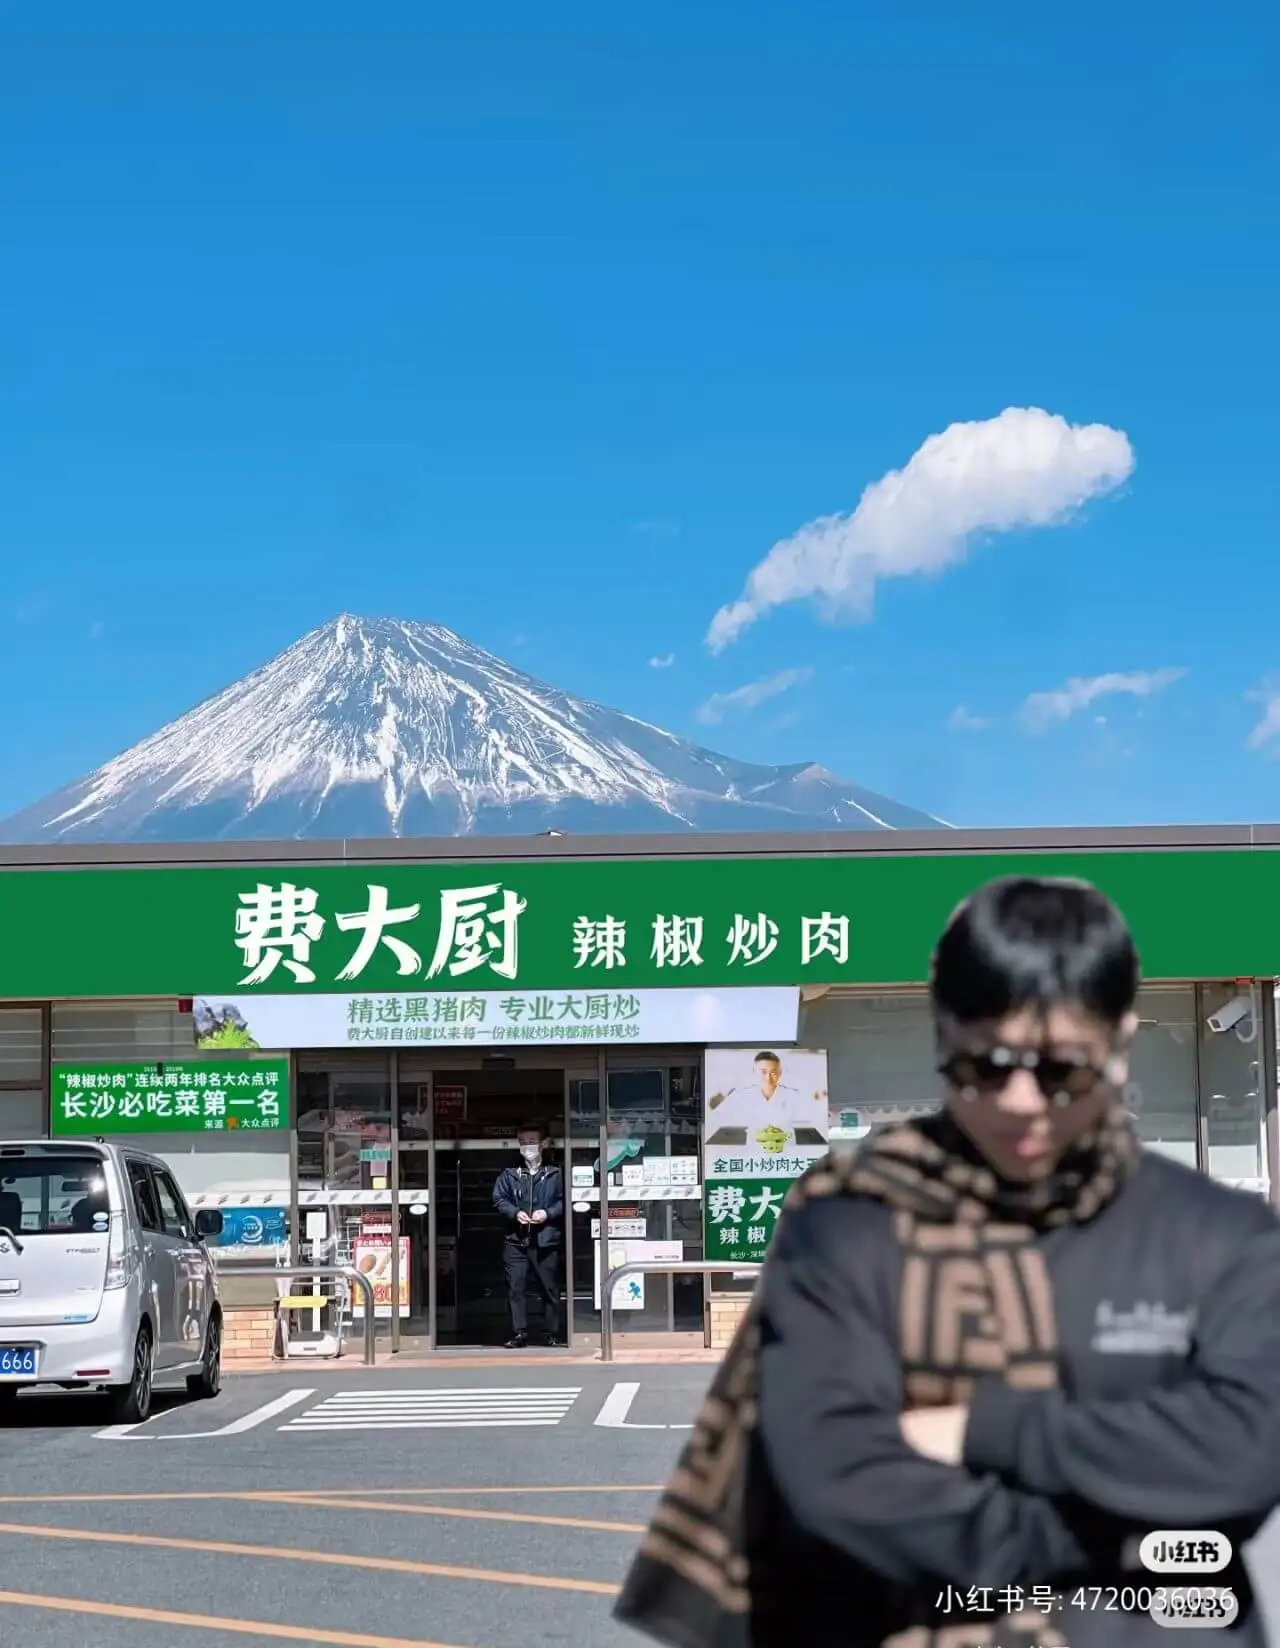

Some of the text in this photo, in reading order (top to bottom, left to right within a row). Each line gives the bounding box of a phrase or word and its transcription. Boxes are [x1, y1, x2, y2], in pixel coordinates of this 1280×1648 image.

[234, 882, 850, 986] 费大厨 辣椒炒肉
[347, 994, 641, 1023] 精选黑猪肉 专业大厨炒
[60, 1089, 280, 1119] 长沙必吃菜第一名
[241, 1117, 280, 1129] 大众点评
[1, 1351, 34, 1370] 666
